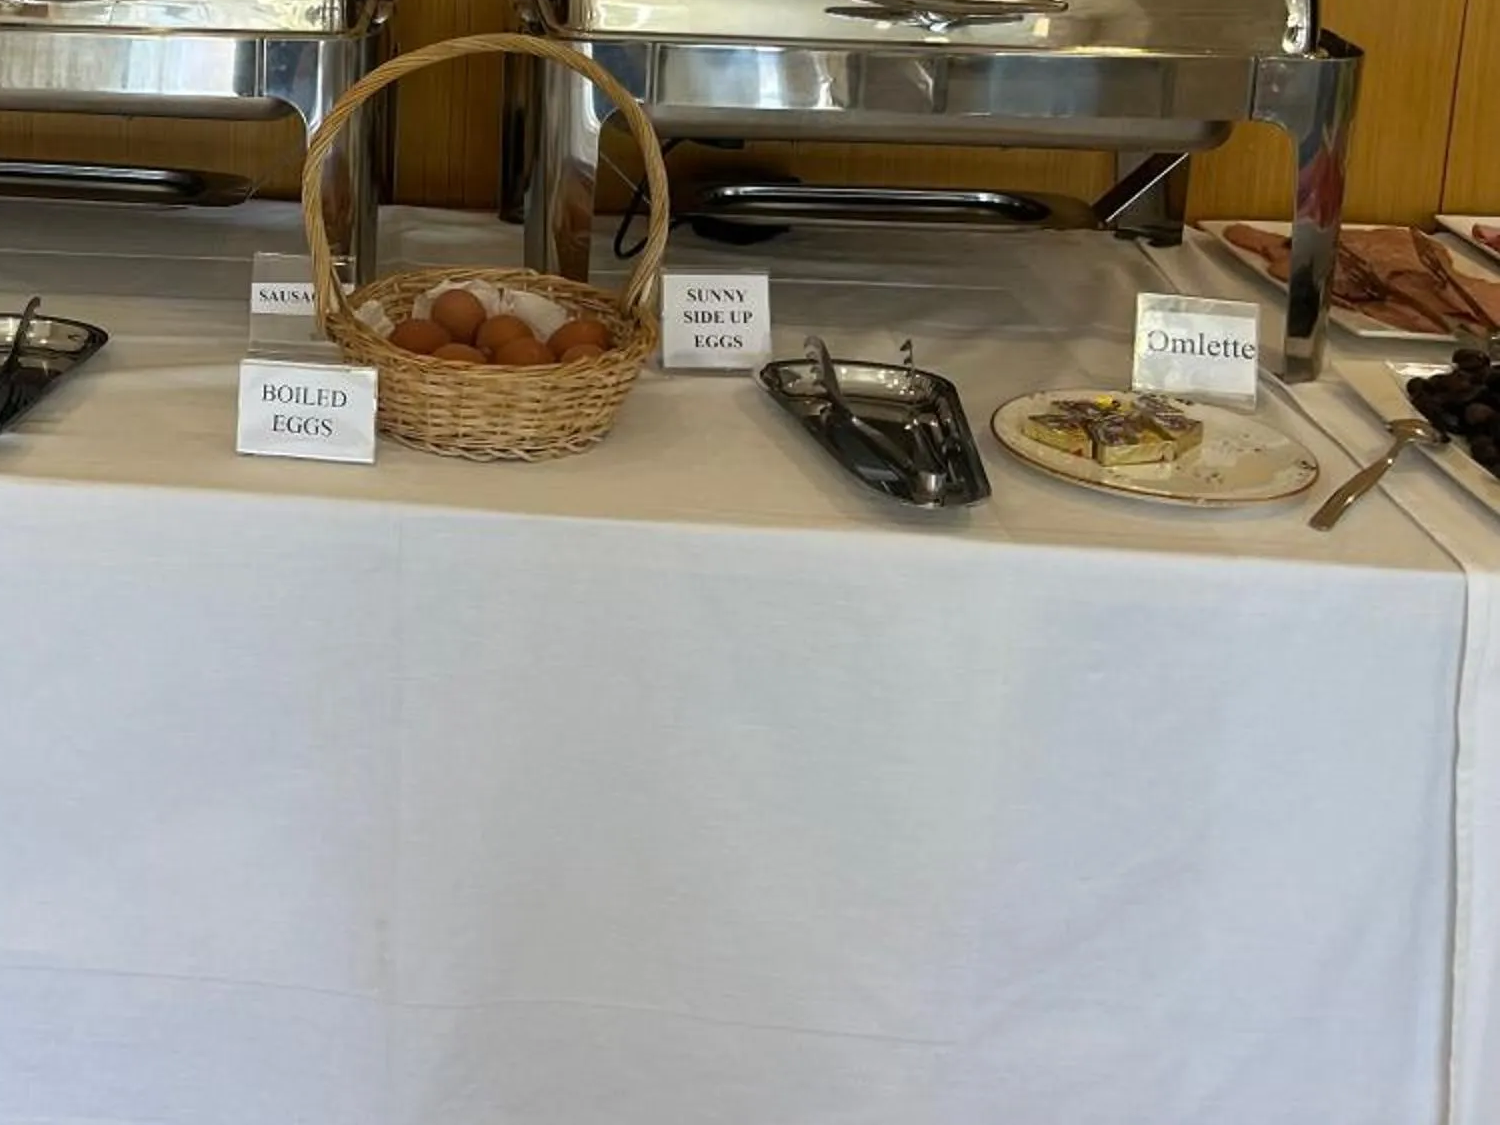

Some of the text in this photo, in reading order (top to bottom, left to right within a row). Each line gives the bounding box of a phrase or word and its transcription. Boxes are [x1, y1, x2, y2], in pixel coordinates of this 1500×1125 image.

[259, 290, 315, 304] SAUSA
[686, 288, 747, 303] SUNNY
[683, 310, 753, 324] SIDE UP
[694, 334, 744, 349] EGGS
[1146, 329, 1256, 360] Omlette
[262, 383, 348, 408] BOILED
[272, 414, 334, 437] EGGS
